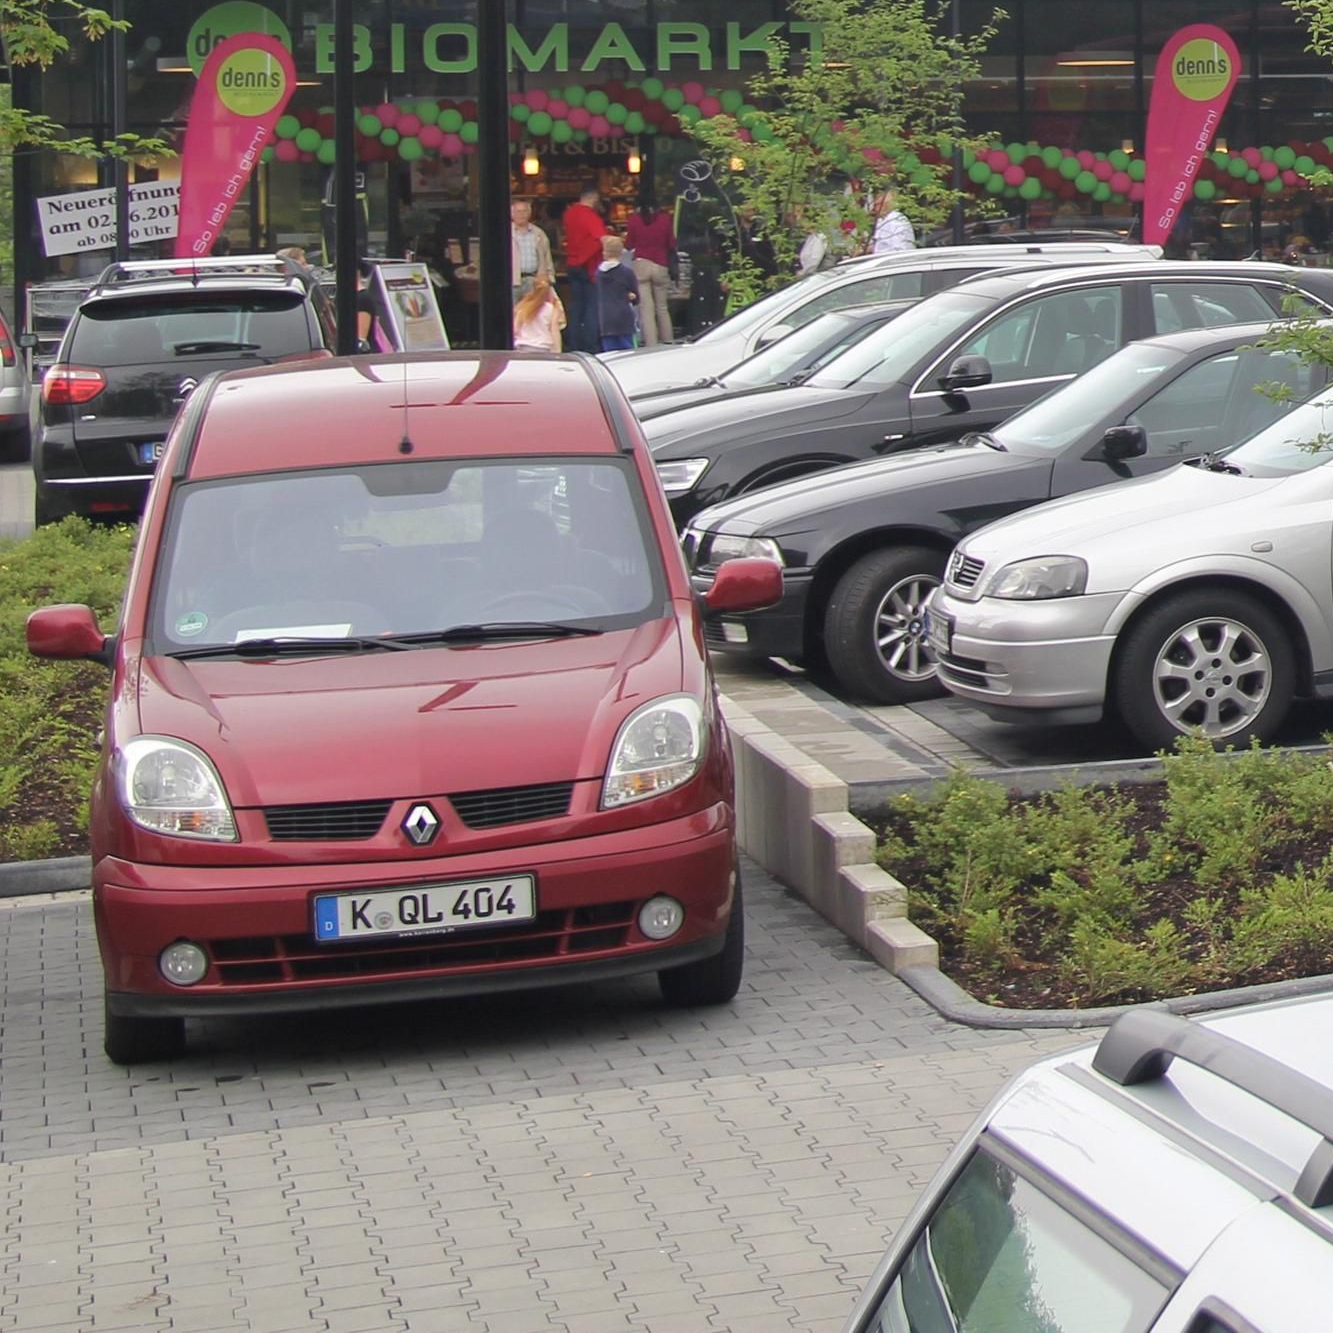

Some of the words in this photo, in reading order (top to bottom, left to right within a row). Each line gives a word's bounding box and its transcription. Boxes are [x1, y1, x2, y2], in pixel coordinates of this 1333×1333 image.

[49, 221, 81, 235] am
[76, 236, 96, 248] ab
[144, 225, 172, 238] Uhr
[351, 898, 374, 931] K
[398, 893, 444, 925] QL
[452, 884, 517, 920] 404
